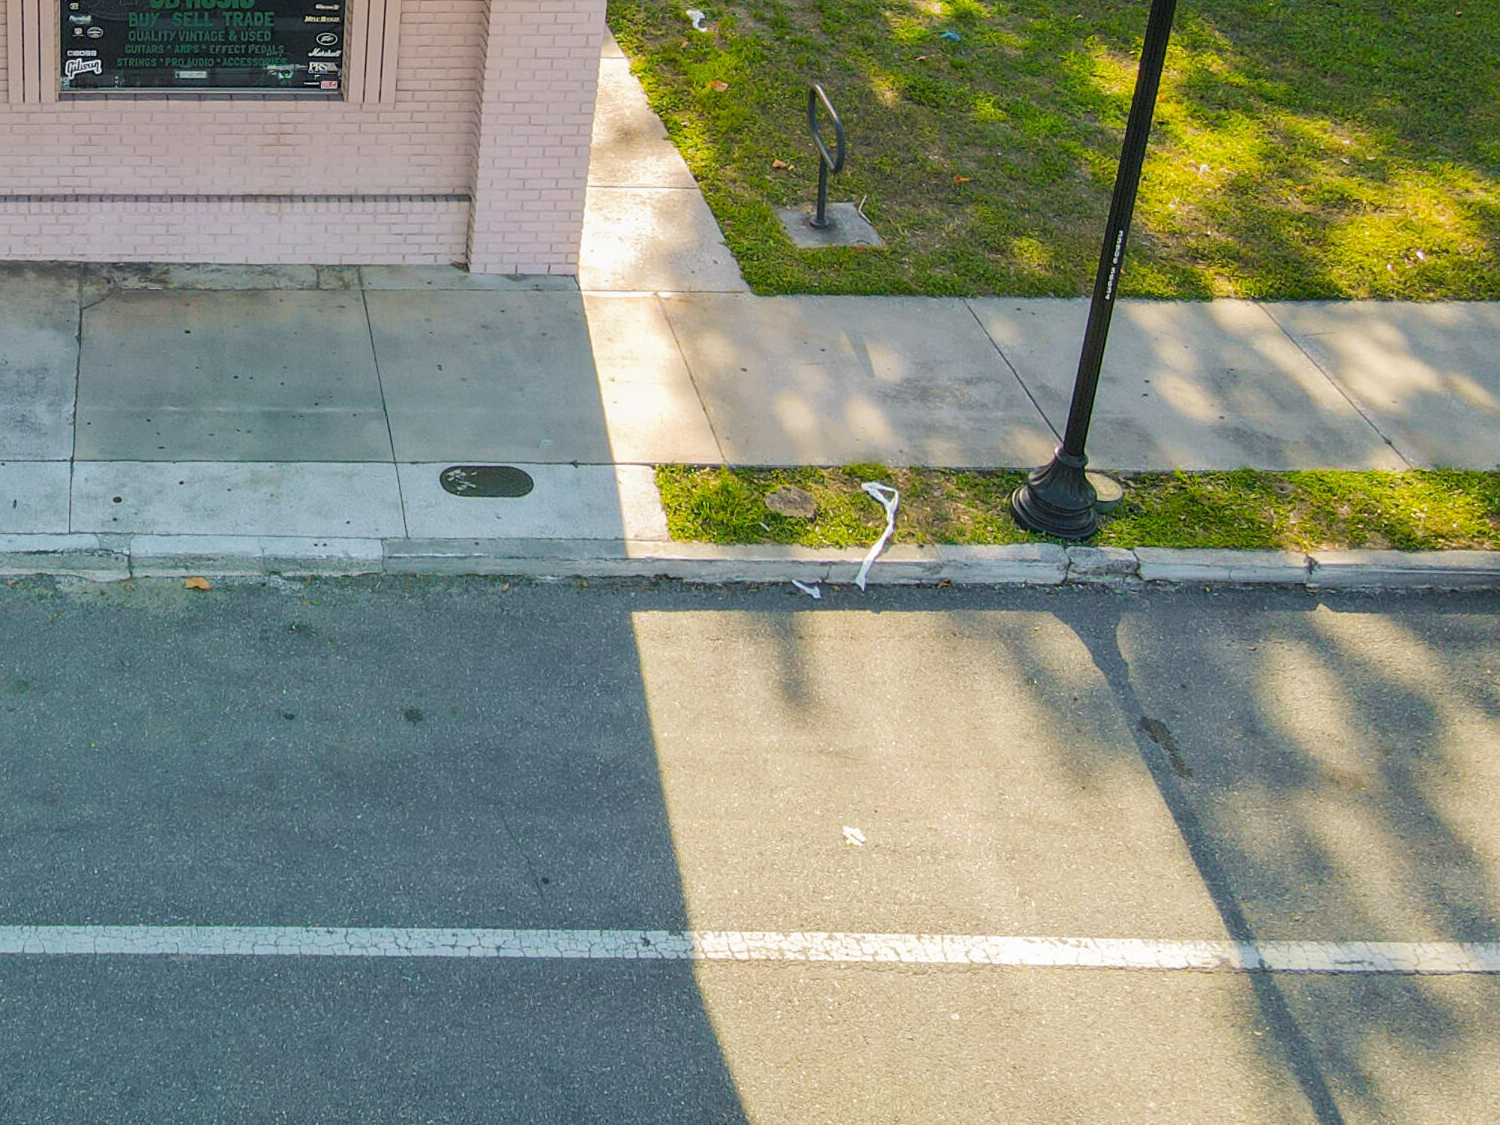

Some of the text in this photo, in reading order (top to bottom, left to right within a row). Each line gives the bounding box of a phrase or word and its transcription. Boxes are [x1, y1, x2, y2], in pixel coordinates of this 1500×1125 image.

[128, 11, 275, 27] BUY SELL TRADE
[128, 29, 272, 42] QUALITY VINTAGE & USED
[124, 44, 285, 56] GUITARS AMPS EFFECT PEDALS
[117, 57, 157, 67] STRINGS
[186, 57, 214, 67] AUDIO
